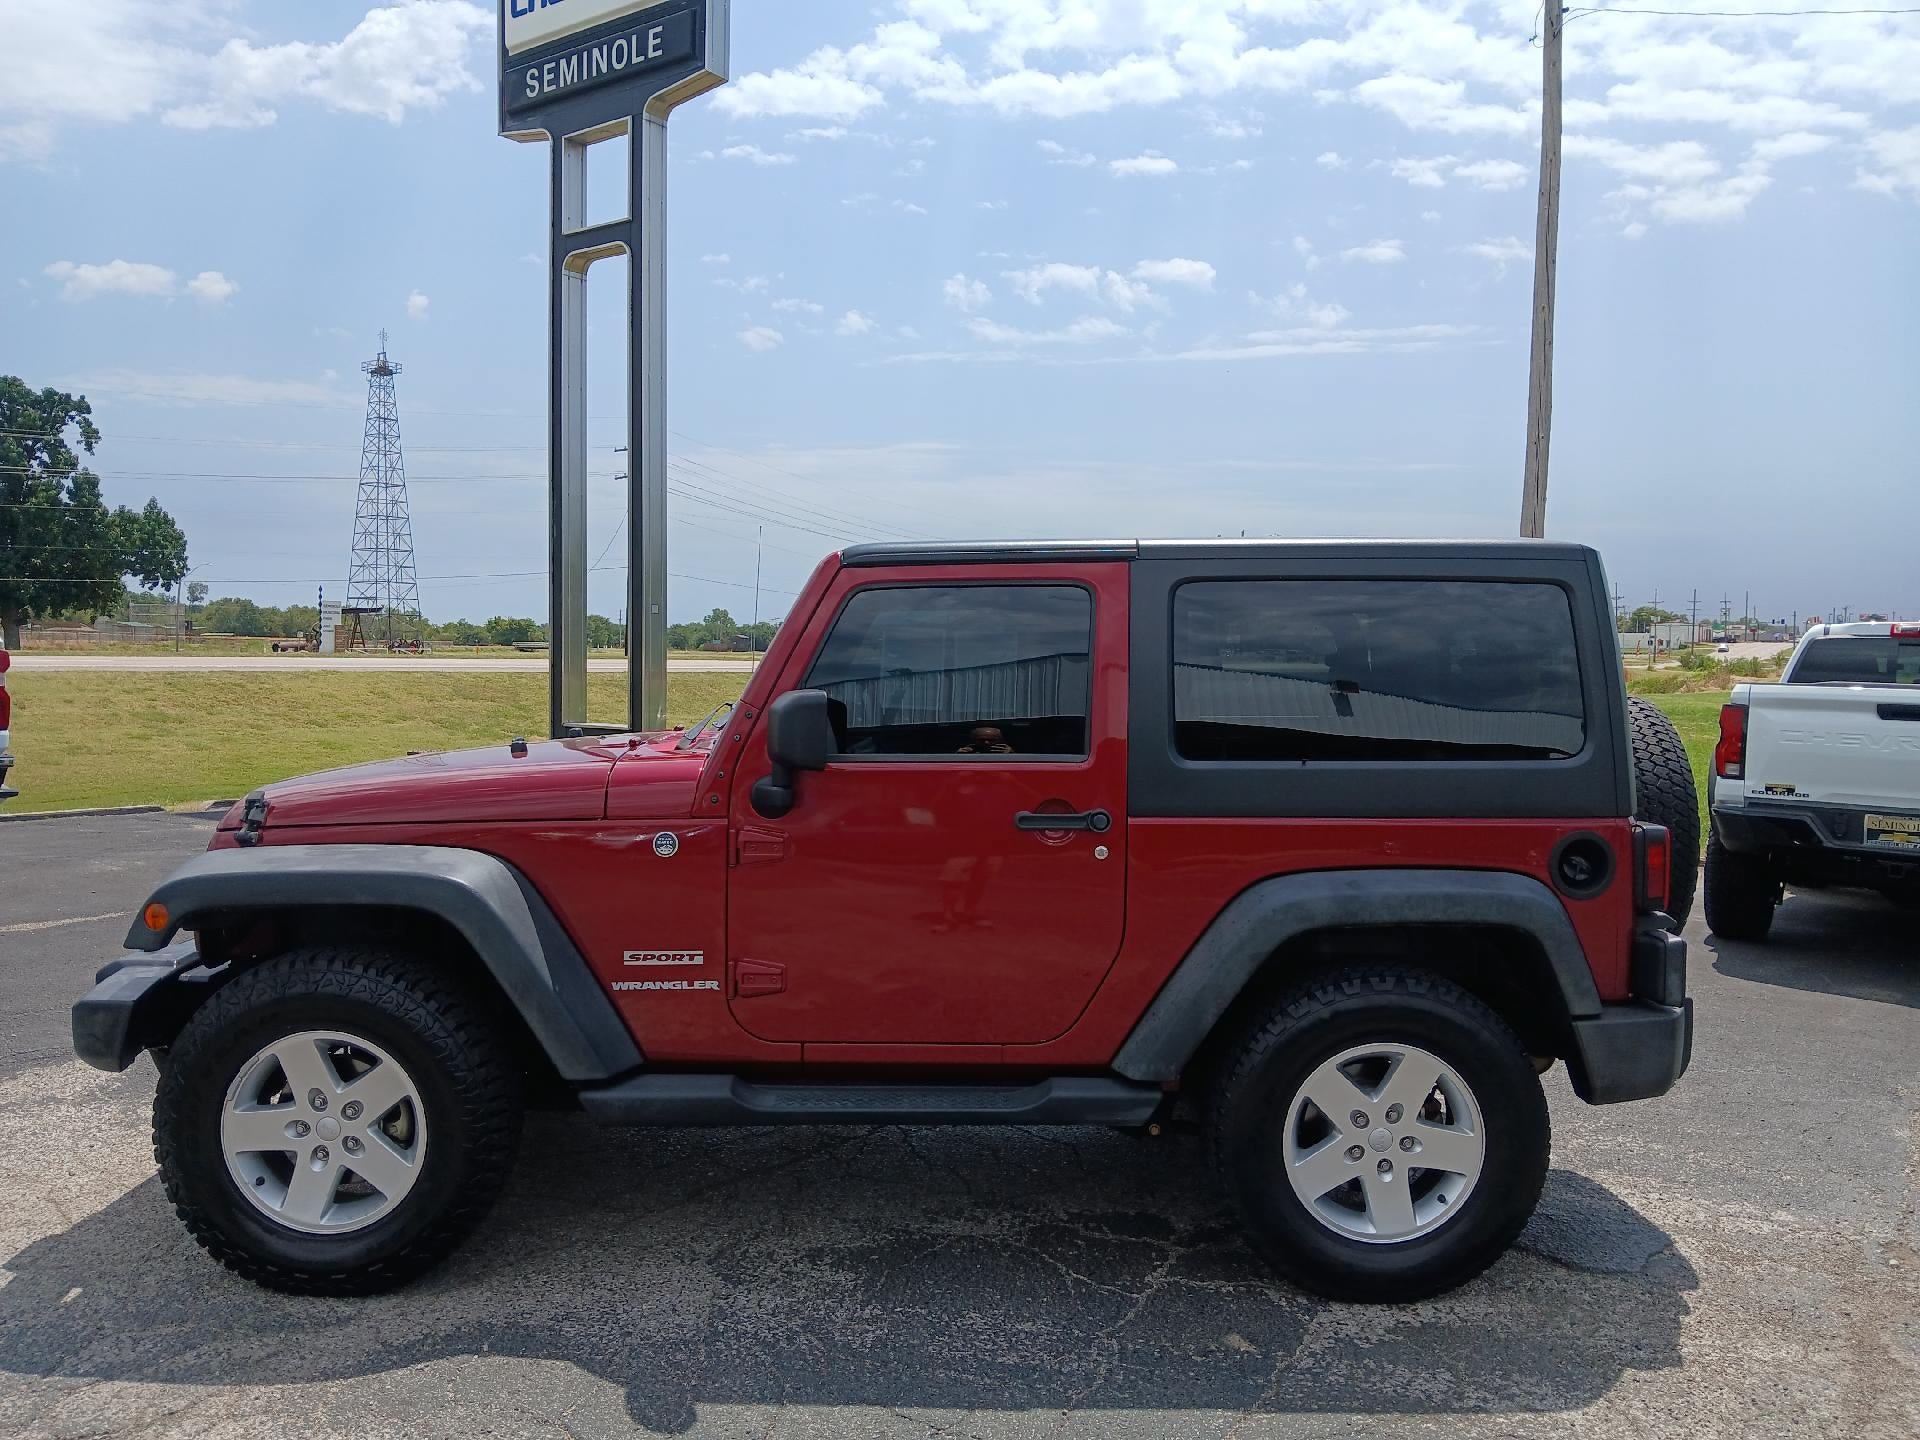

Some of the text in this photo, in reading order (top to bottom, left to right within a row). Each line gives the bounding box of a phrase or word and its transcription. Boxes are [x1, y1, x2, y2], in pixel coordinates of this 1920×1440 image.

[525, 25, 664, 98] SEMINOLE
[624, 952, 704, 963] SPORT
[611, 980, 720, 990] WRANGLER
